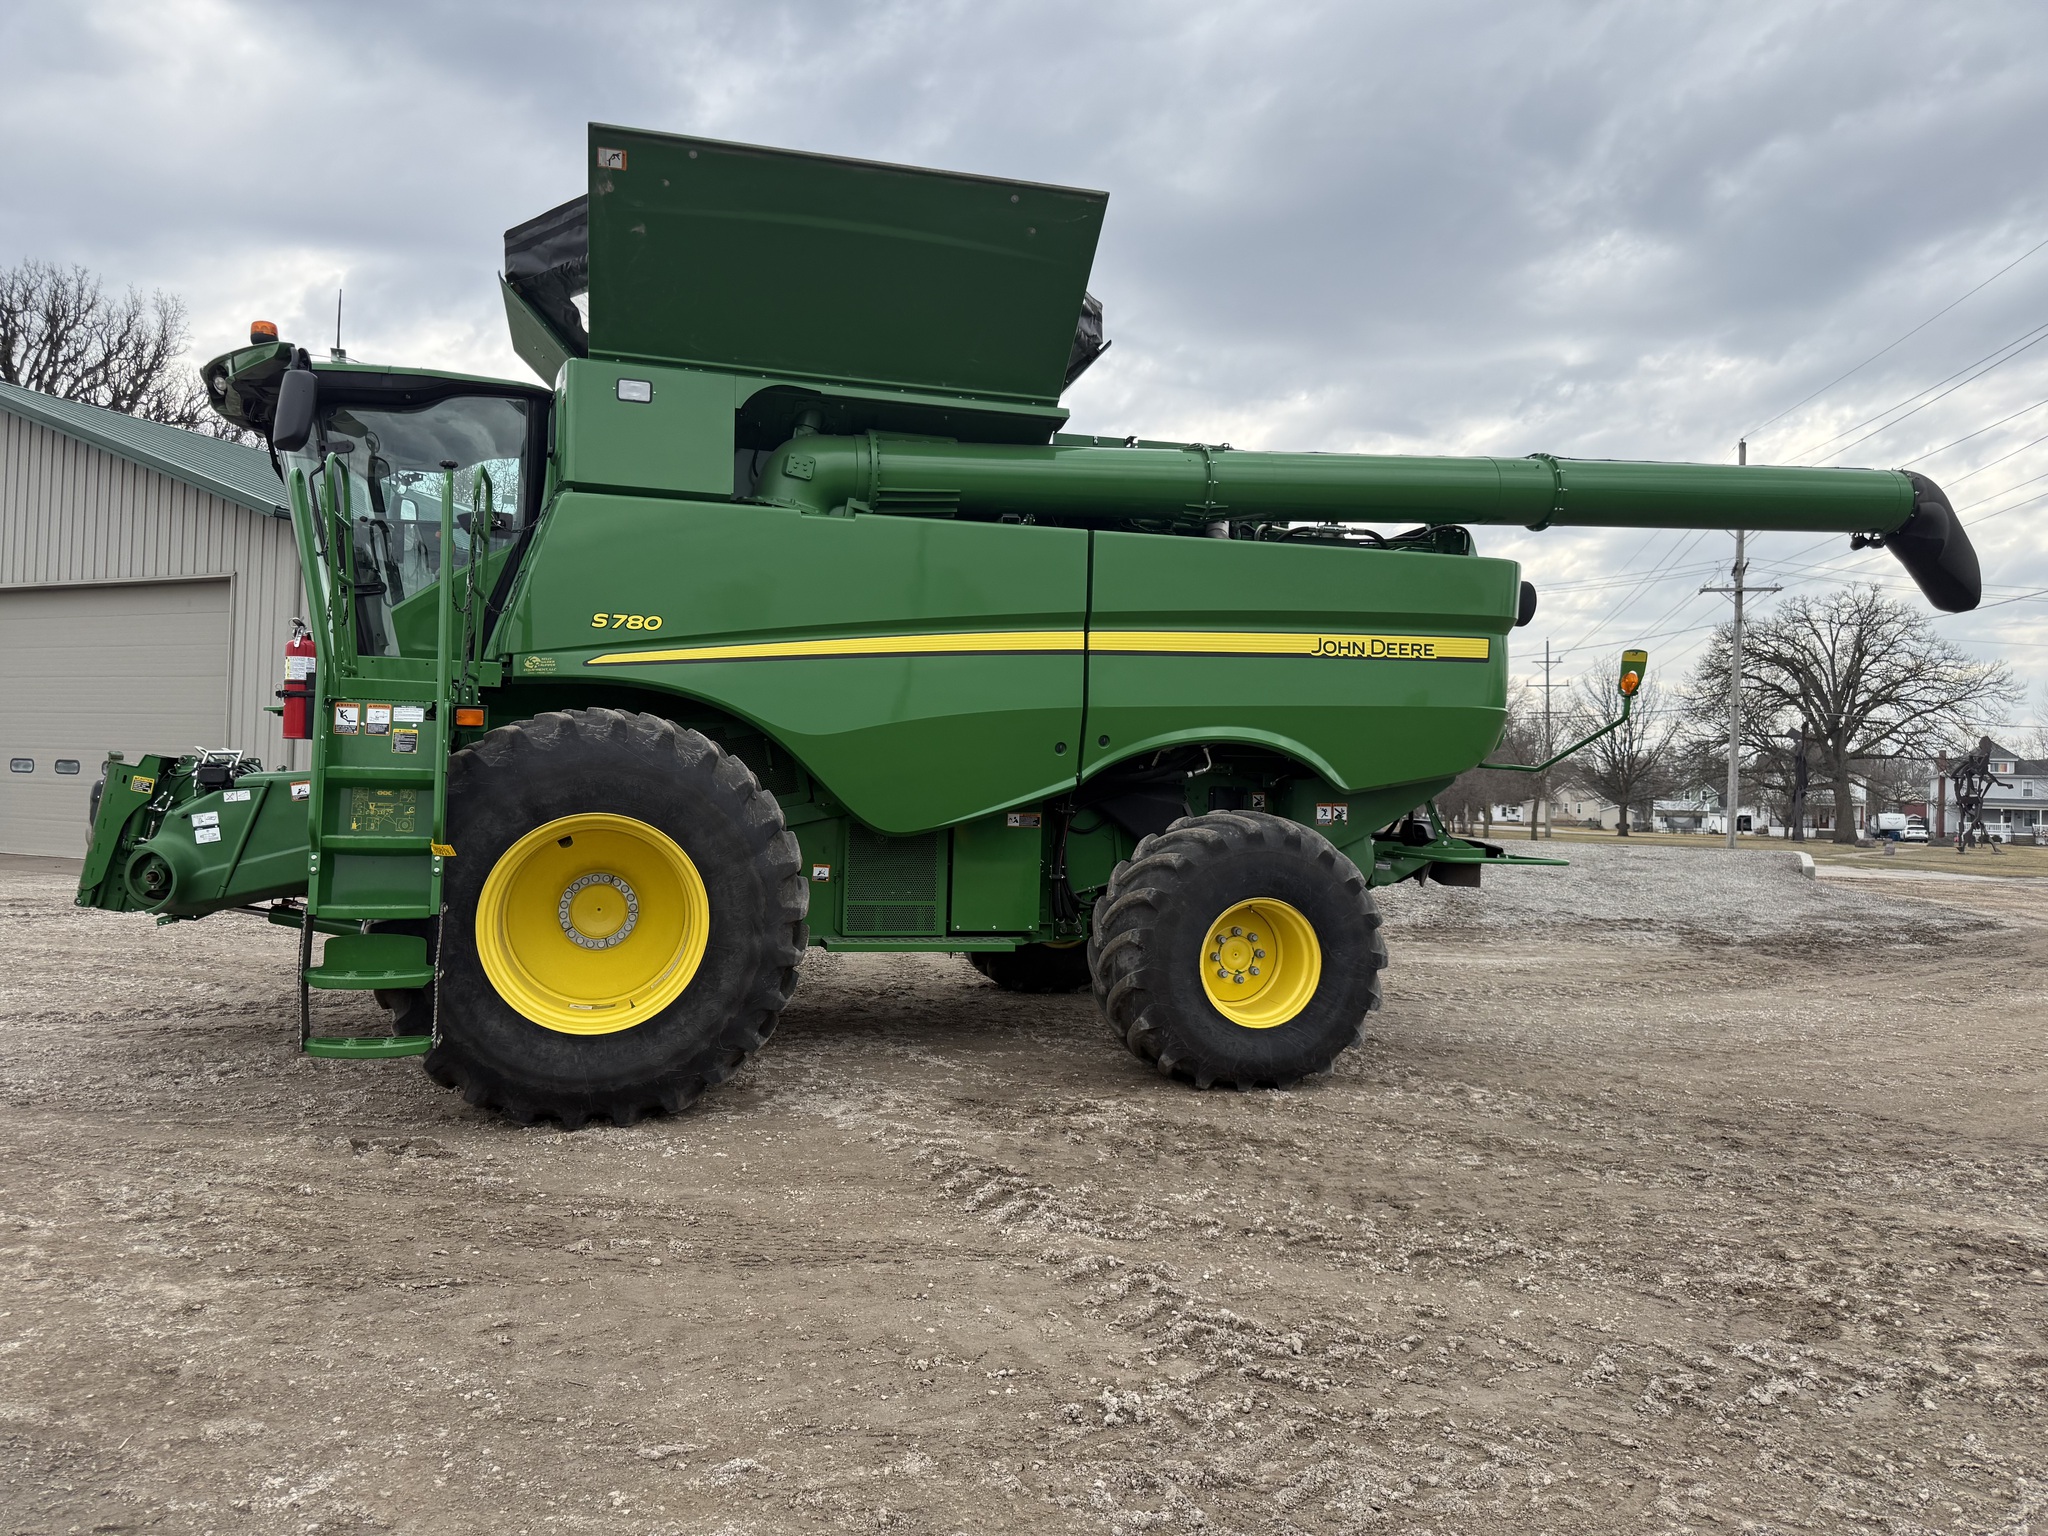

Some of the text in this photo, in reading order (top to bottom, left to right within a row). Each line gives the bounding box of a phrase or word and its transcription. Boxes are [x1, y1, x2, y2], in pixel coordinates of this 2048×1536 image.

[591, 612, 663, 631] S780
[1311, 637, 1435, 657] JOHN DEERE
